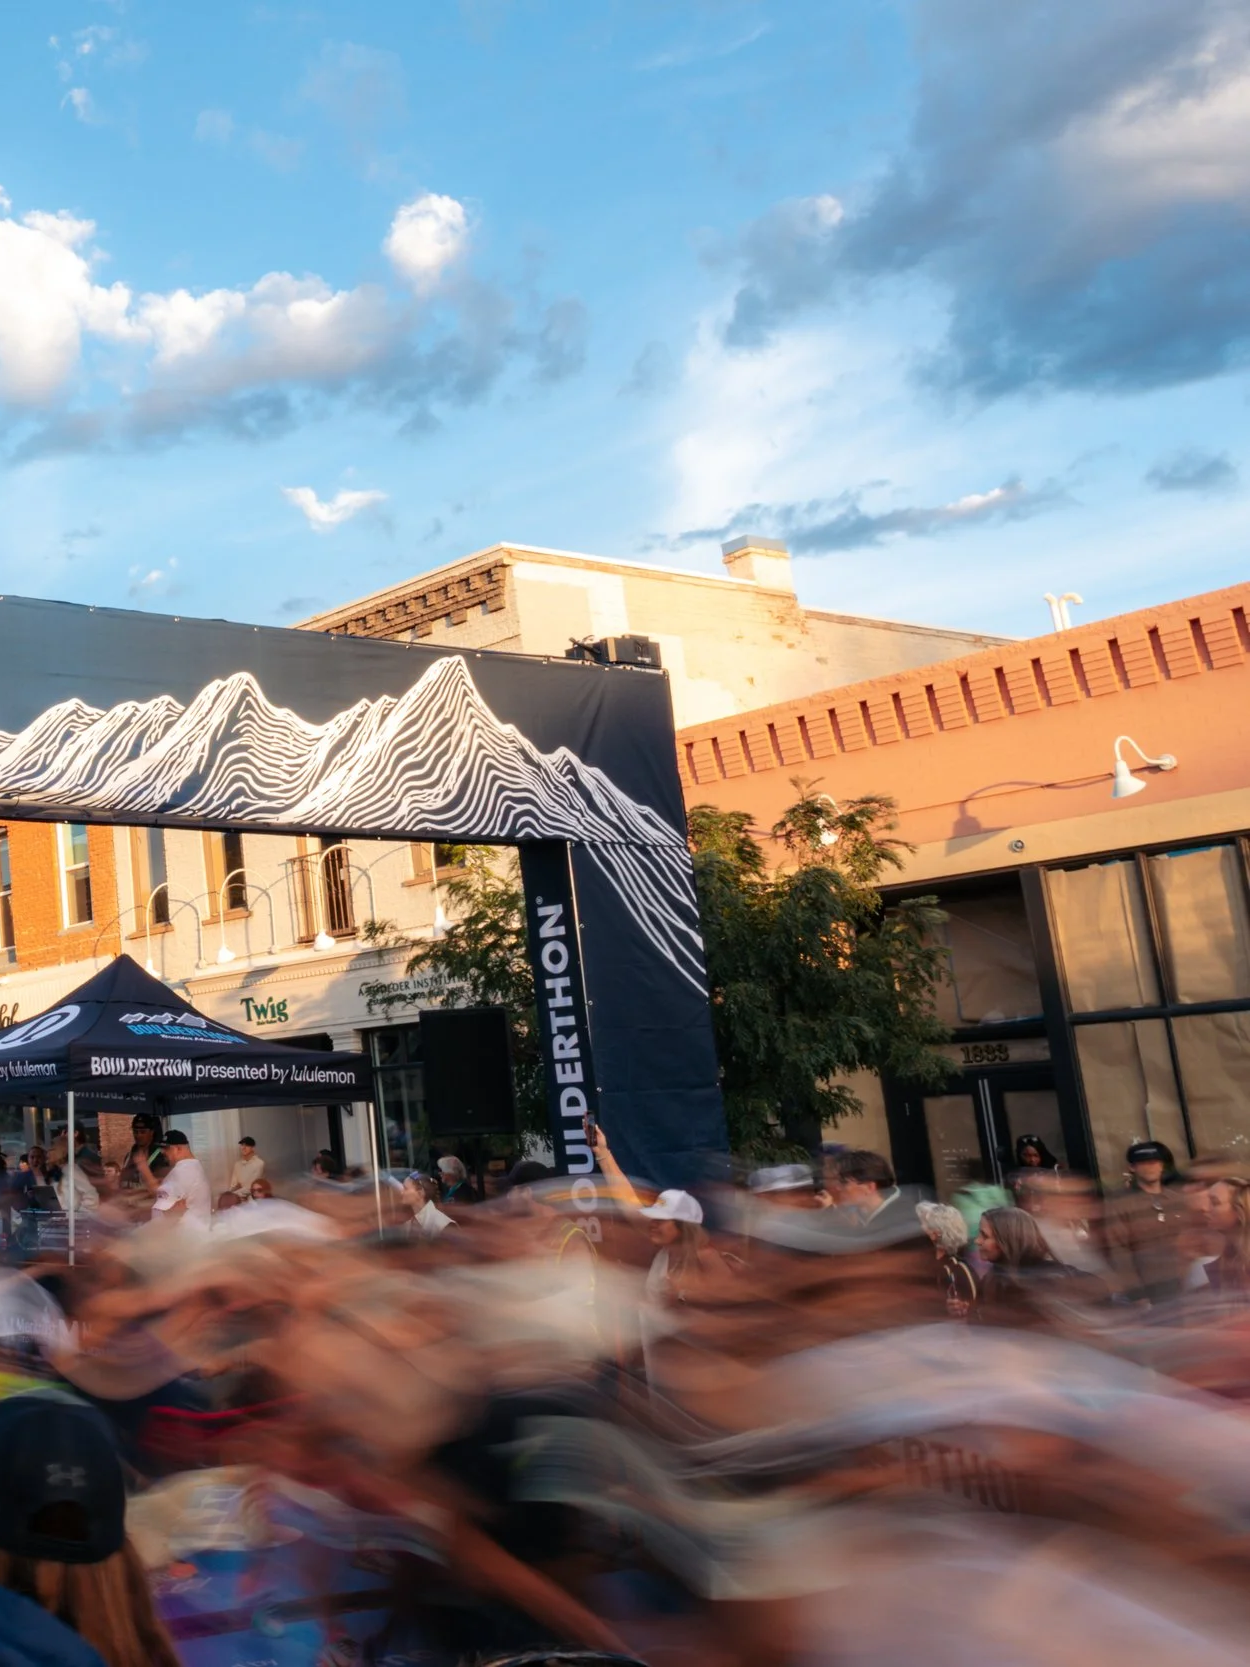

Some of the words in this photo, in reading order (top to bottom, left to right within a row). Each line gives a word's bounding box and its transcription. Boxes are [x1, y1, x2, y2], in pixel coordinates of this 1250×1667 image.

[239, 996, 289, 1023] Twig
[8, 1060, 58, 1078] lululemon
[90, 1056, 193, 1077] BOULDERTHON
[195, 1064, 268, 1081] presented
[271, 1064, 290, 1085] by
[290, 1064, 356, 1085] lululemon
